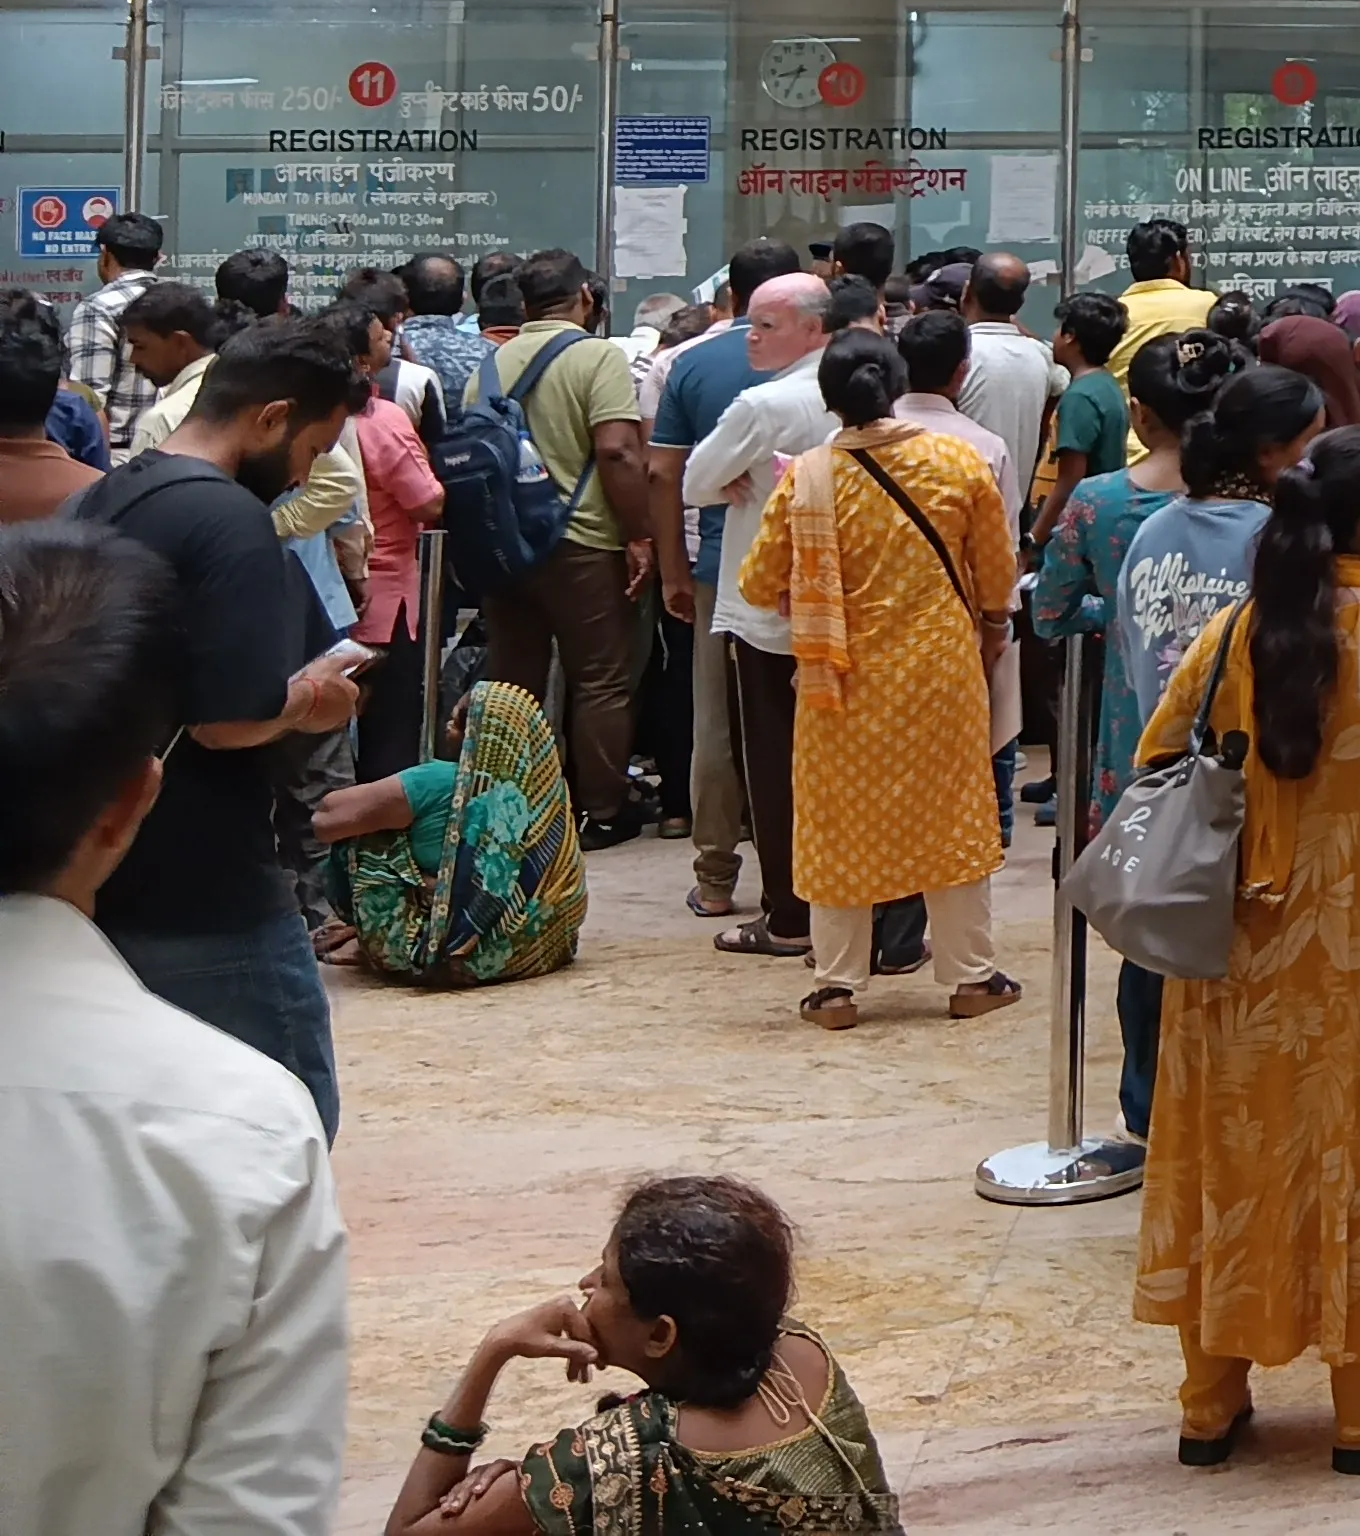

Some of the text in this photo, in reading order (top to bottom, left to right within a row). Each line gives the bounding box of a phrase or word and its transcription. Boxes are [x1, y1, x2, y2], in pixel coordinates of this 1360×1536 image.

[357, 70, 385, 99] 11
[825, 71, 856, 97] 10
[281, 86, 343, 112] 250/-
[532, 83, 583, 113] 50/-
[269, 129, 478, 152] REGISTRATION
[741, 128, 947, 151] REGISTRATION
[367, 156, 455, 183] पंजीकरण
[737, 159, 967, 202] ऑन लाइन रजिस्ट्रेशन
[1175, 167, 1202, 193] ON
[1208, 167, 1252, 193] LINE
[1266, 162, 1310, 193] ऑन
[295, 192, 309, 204] TO
[315, 192, 356, 205] FRIDAY
[32, 231, 98, 241] NO FACE MAS
[45, 244, 92, 253] NO ENTRY
[244, 233, 298, 248] SATURDAY
[1084, 228, 1129, 244] (REFFE
[1217, 273, 1277, 302] महिला
[1131, 552, 1251, 612] Billionaire
[1100, 844, 1140, 873] AGE
